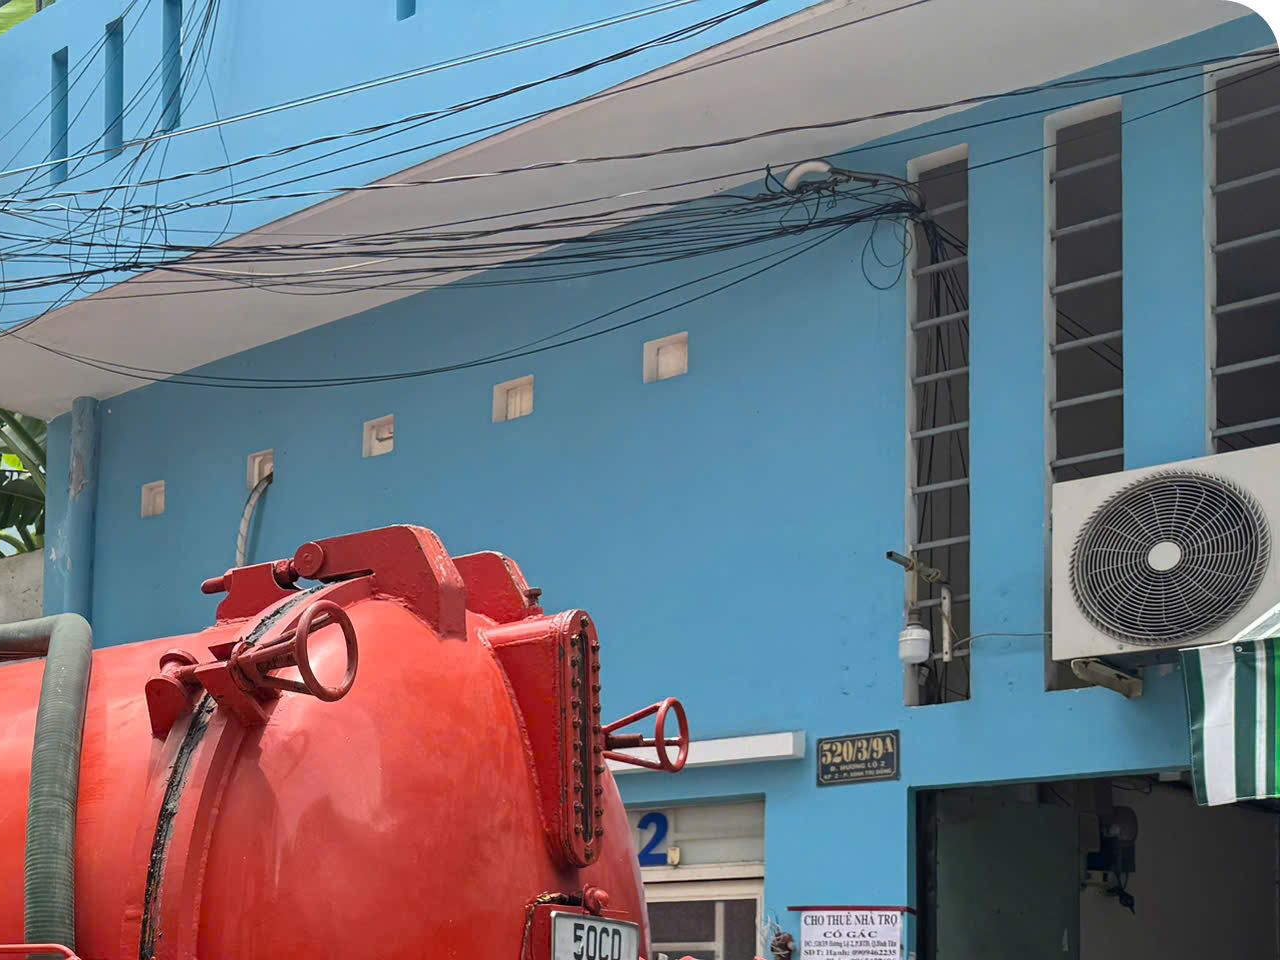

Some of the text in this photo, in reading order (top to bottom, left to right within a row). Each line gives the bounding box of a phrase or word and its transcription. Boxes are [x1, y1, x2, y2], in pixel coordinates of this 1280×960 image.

[822, 736, 894, 765] 520/3/9A
[637, 812, 668, 866] 2
[803, 914, 825, 926] CHO
[855, 912, 875, 926] NHÀ
[878, 914, 898, 927] TRỌ
[823, 929, 878, 939] CÓ GÁC
